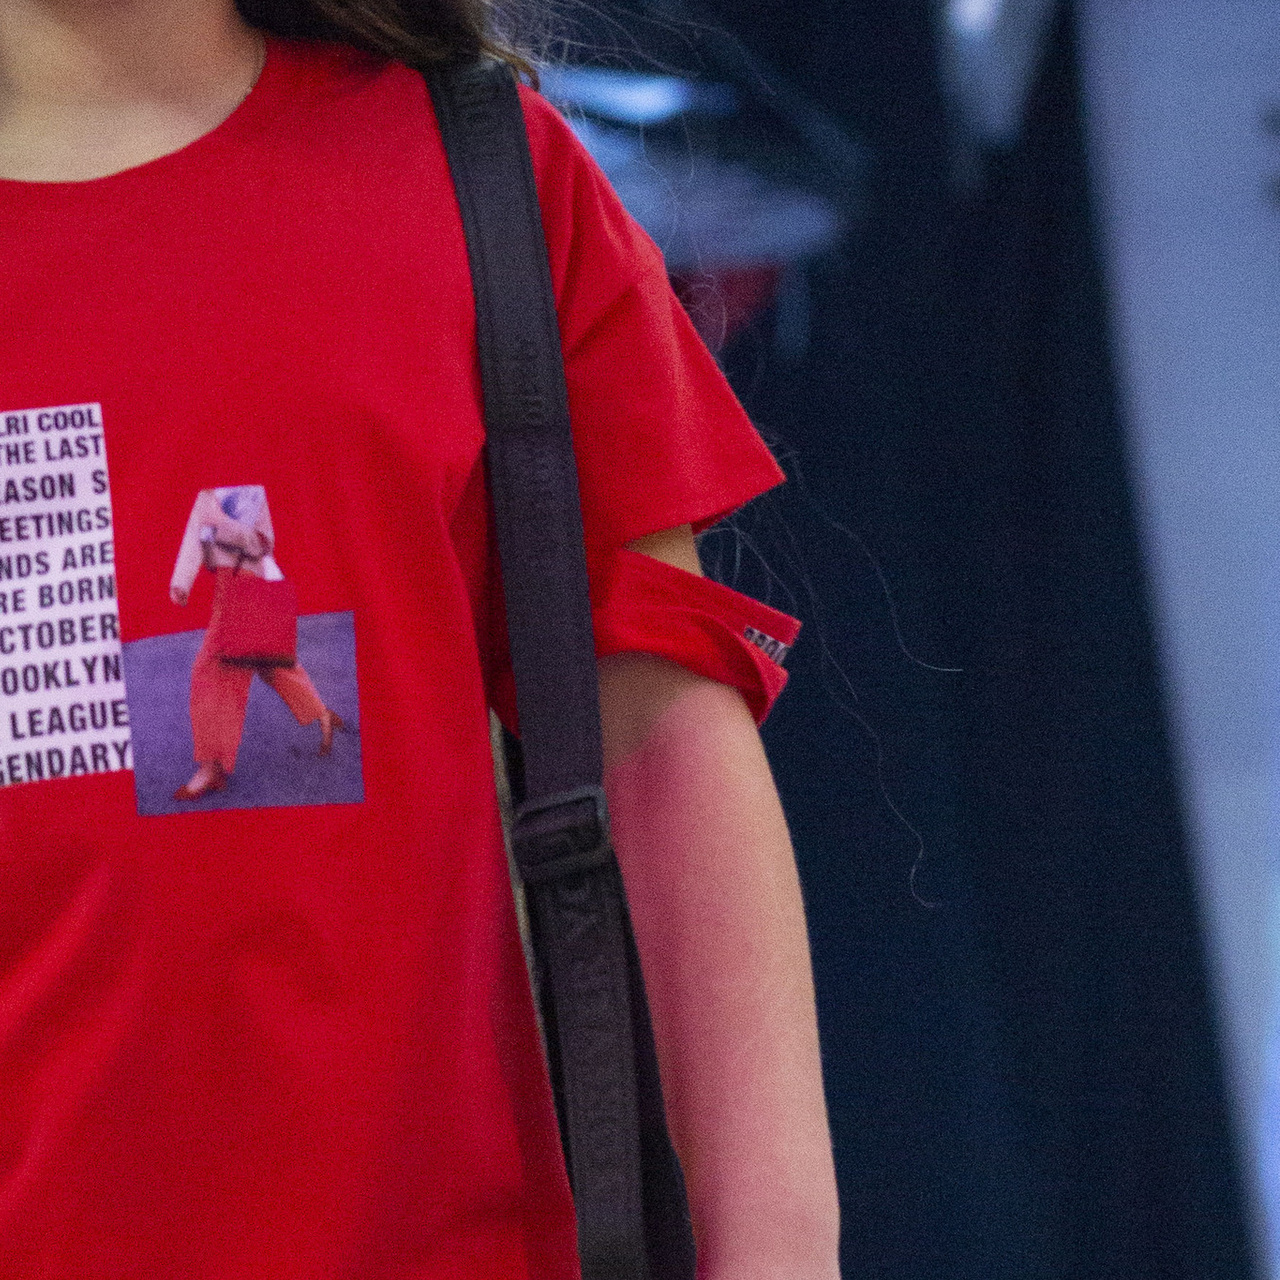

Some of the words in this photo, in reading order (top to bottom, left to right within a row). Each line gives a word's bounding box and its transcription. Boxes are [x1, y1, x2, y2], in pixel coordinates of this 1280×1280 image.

[37, 408, 101, 431] COOL
[44, 434, 102, 461] LAST
[91, 469, 107, 494] S
[62, 540, 114, 570] ARE
[38, 574, 116, 609] BORN
[10, 700, 130, 740] LEAGUE
